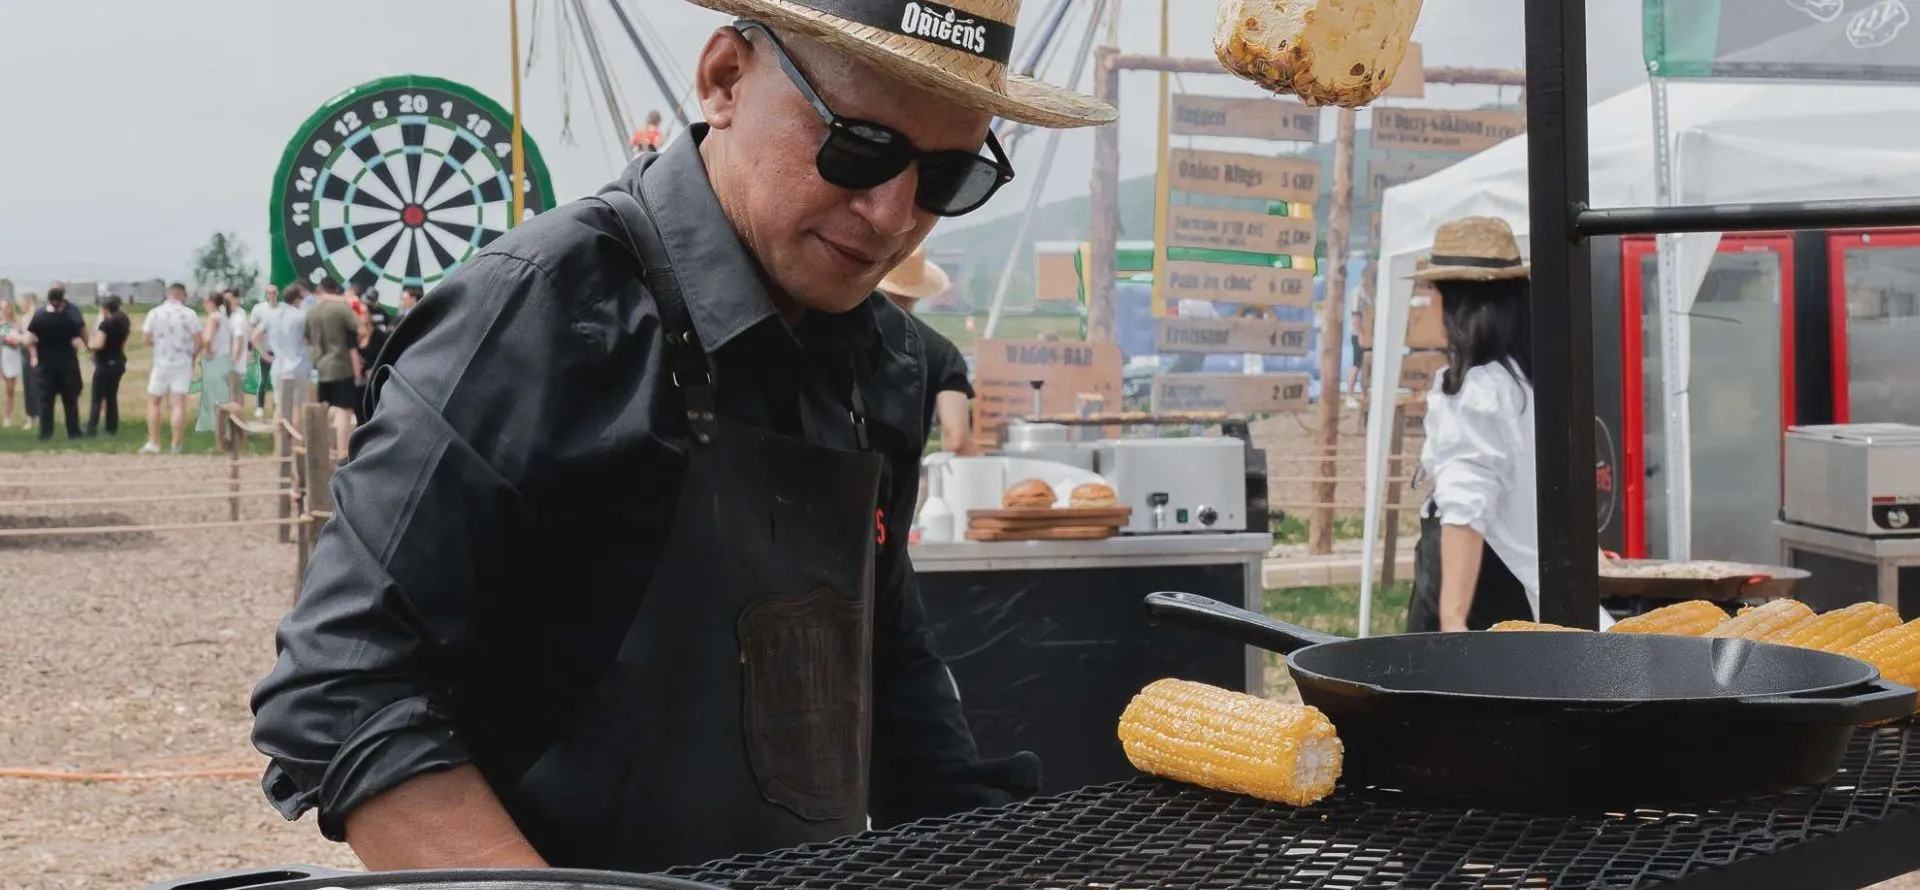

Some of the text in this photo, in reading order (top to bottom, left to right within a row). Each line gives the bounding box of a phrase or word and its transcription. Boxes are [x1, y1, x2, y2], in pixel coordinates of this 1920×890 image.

[901, 2, 986, 53] ORIGENS
[372, 101, 388, 119] 5
[398, 95, 429, 113] 20
[440, 101, 453, 119] 1
[334, 111, 362, 136] 12
[466, 113, 491, 138] 18
[313, 139, 331, 157] 9
[494, 142, 511, 158] 4
[295, 166, 317, 191] 14
[1178, 159, 1220, 181] Onion
[1224, 163, 1263, 187] Rings
[1292, 174, 1315, 190] CHF
[292, 202, 310, 226] 11
[1293, 230, 1311, 245] CHF
[1169, 272, 1200, 290] Pain
[1281, 278, 1302, 295] CHF
[1165, 327, 1231, 346] Croissant
[1282, 331, 1305, 347] CHF
[1272, 384, 1304, 400] 2 CHF
